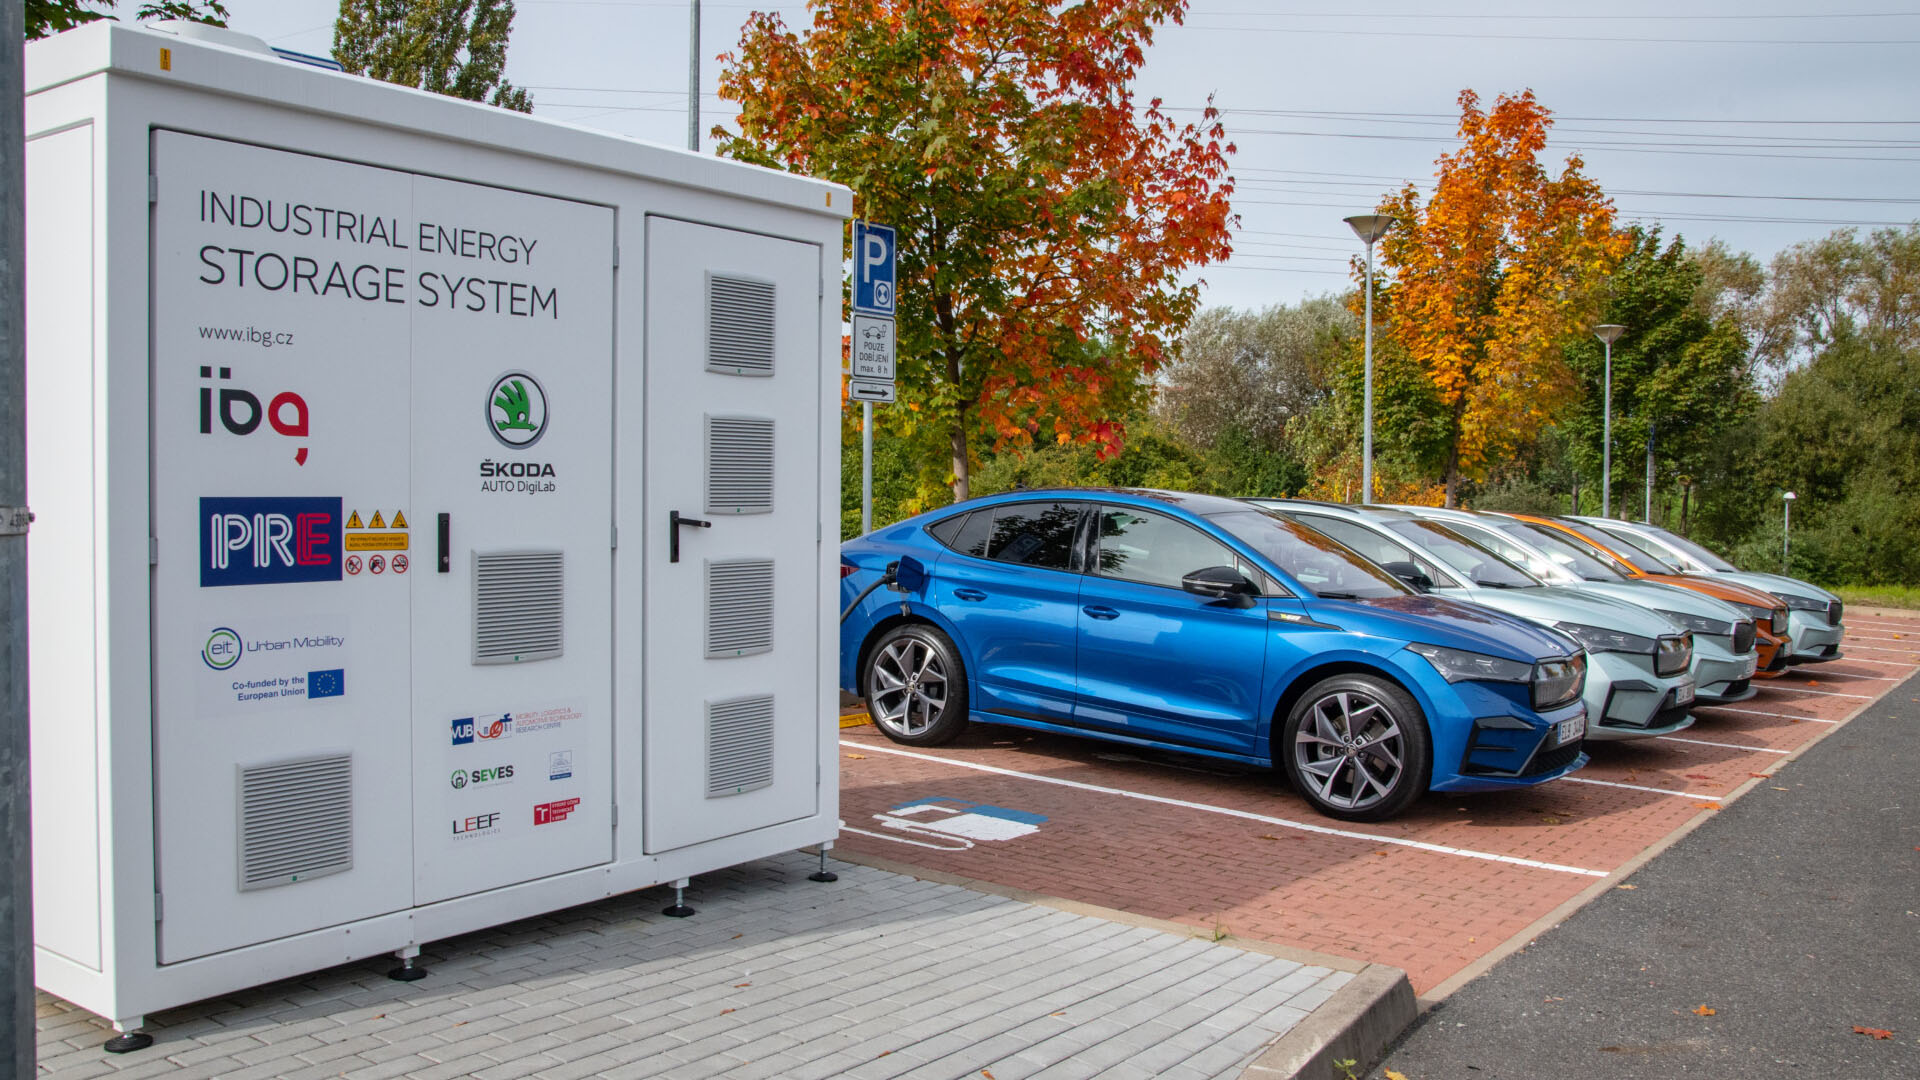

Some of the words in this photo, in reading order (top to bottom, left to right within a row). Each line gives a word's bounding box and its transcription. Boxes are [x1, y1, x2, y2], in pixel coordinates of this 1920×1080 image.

[200, 189, 408, 249] INDUSTRIAL
[418, 222, 538, 265] ENERGY
[863, 232, 887, 284] P
[199, 245, 405, 304] STORAGE
[418, 271, 558, 320] SYSTEM
[199, 326, 294, 348] www.ibg.cz
[863, 341, 886, 352] POUZE
[859, 351, 889, 363] DOBÍJENÍ
[860, 365, 876, 373] max.
[877, 365, 882, 374] 8
[480, 458, 556, 478] ŠKODA
[481, 480, 515, 492] AUTO
[517, 480, 556, 495] DigiLab
[211, 512, 332, 570] PRE
[211, 641, 233, 655] eit
[247, 640, 291, 652] Urban
[293, 635, 344, 649] Mobility
[232, 678, 277, 690] Co-funded
[279, 678, 289, 687] by
[291, 676, 305, 685] the
[237, 689, 279, 702] European
[281, 686, 305, 697] Union
[450, 724, 474, 740] VUB
[472, 765, 514, 783] SEVES
[453, 812, 500, 834] LEEF
